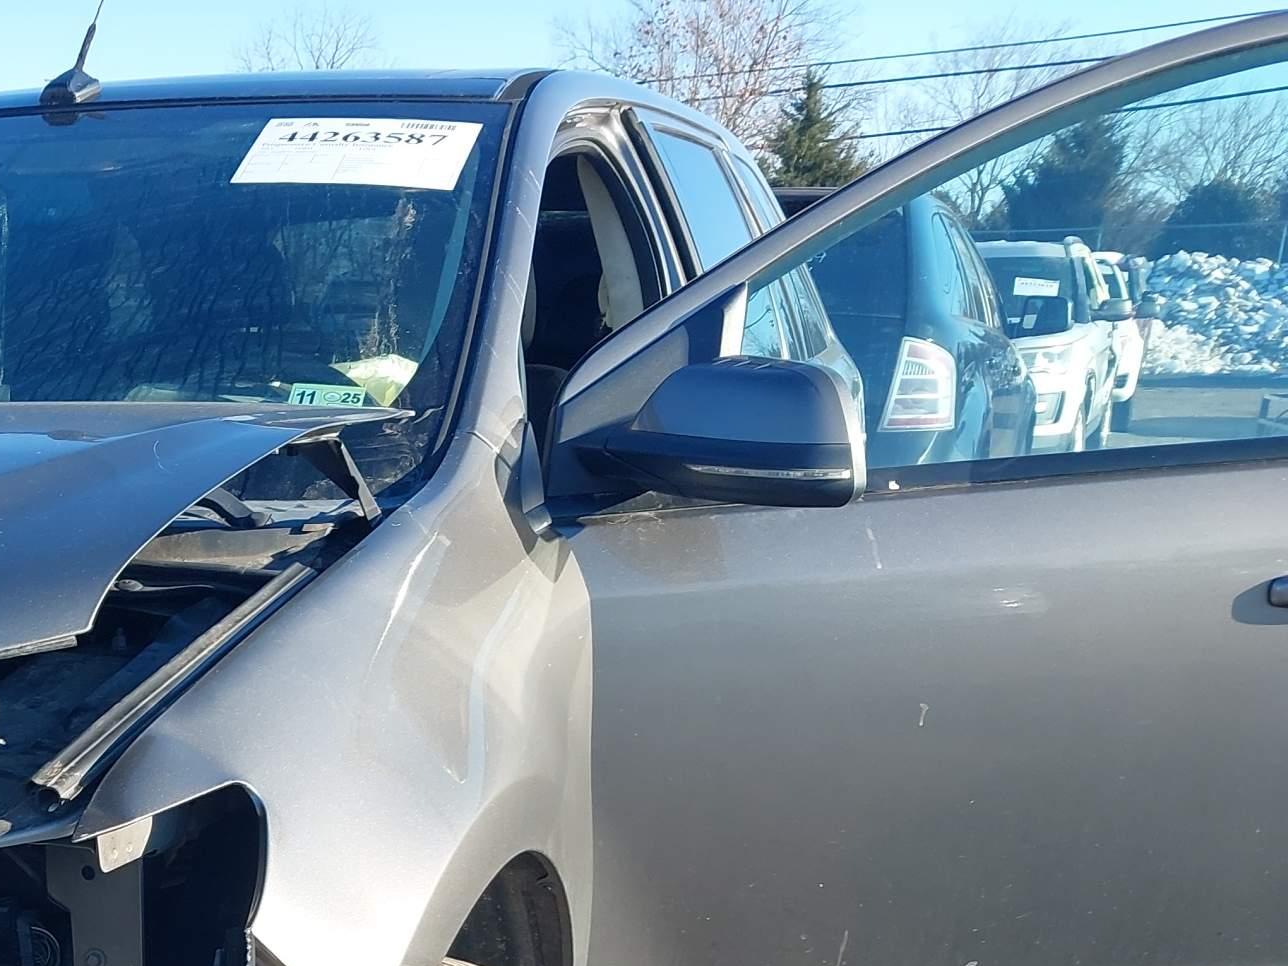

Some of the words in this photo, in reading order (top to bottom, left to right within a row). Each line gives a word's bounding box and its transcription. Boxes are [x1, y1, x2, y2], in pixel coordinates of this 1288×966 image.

[278, 130, 448, 146] 44263587
[295, 390, 317, 405] 11
[341, 392, 361, 405] 25
